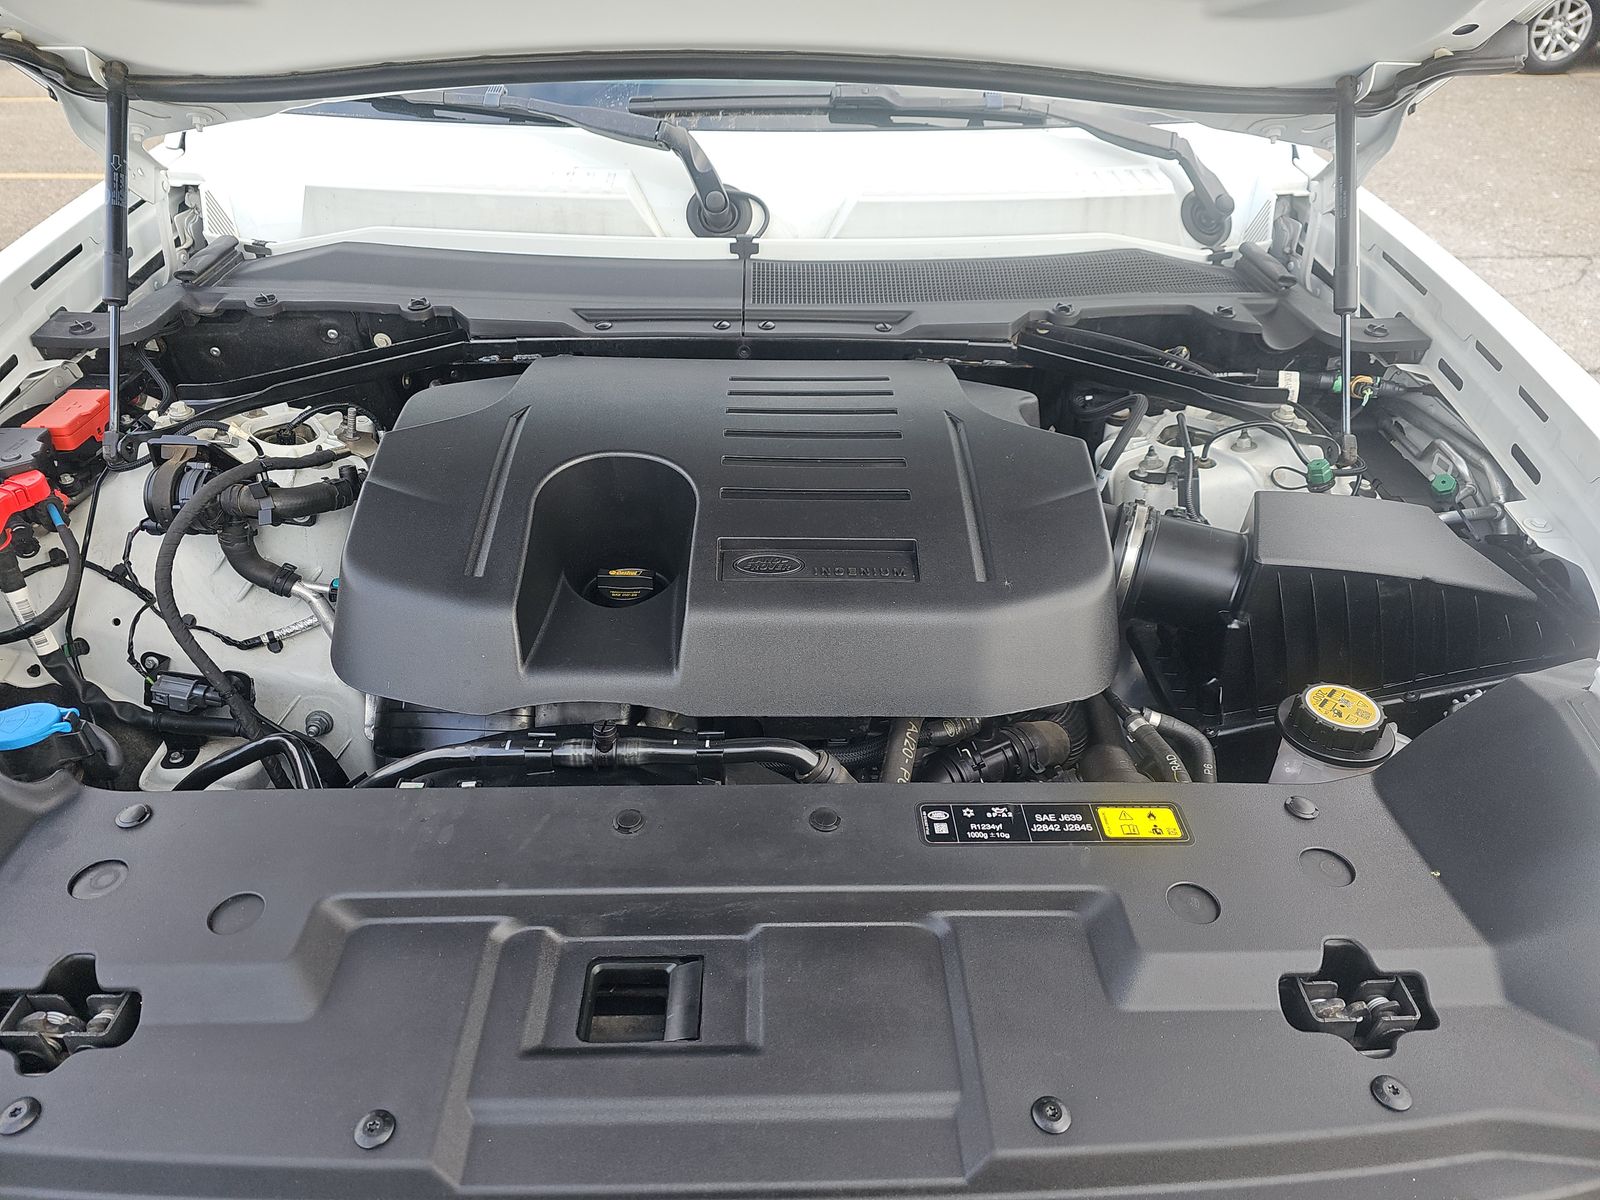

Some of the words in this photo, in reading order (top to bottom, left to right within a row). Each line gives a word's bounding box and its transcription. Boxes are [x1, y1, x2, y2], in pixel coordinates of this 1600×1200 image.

[814, 567, 906, 577] INGENIUM
[1035, 813, 1057, 822] SAE
[1058, 813, 1083, 822] J639
[970, 823, 1003, 831] R1234yf
[1031, 823, 1061, 832] J2842
[1063, 823, 1093, 832] J2845
[967, 832, 989, 840] 1000g
